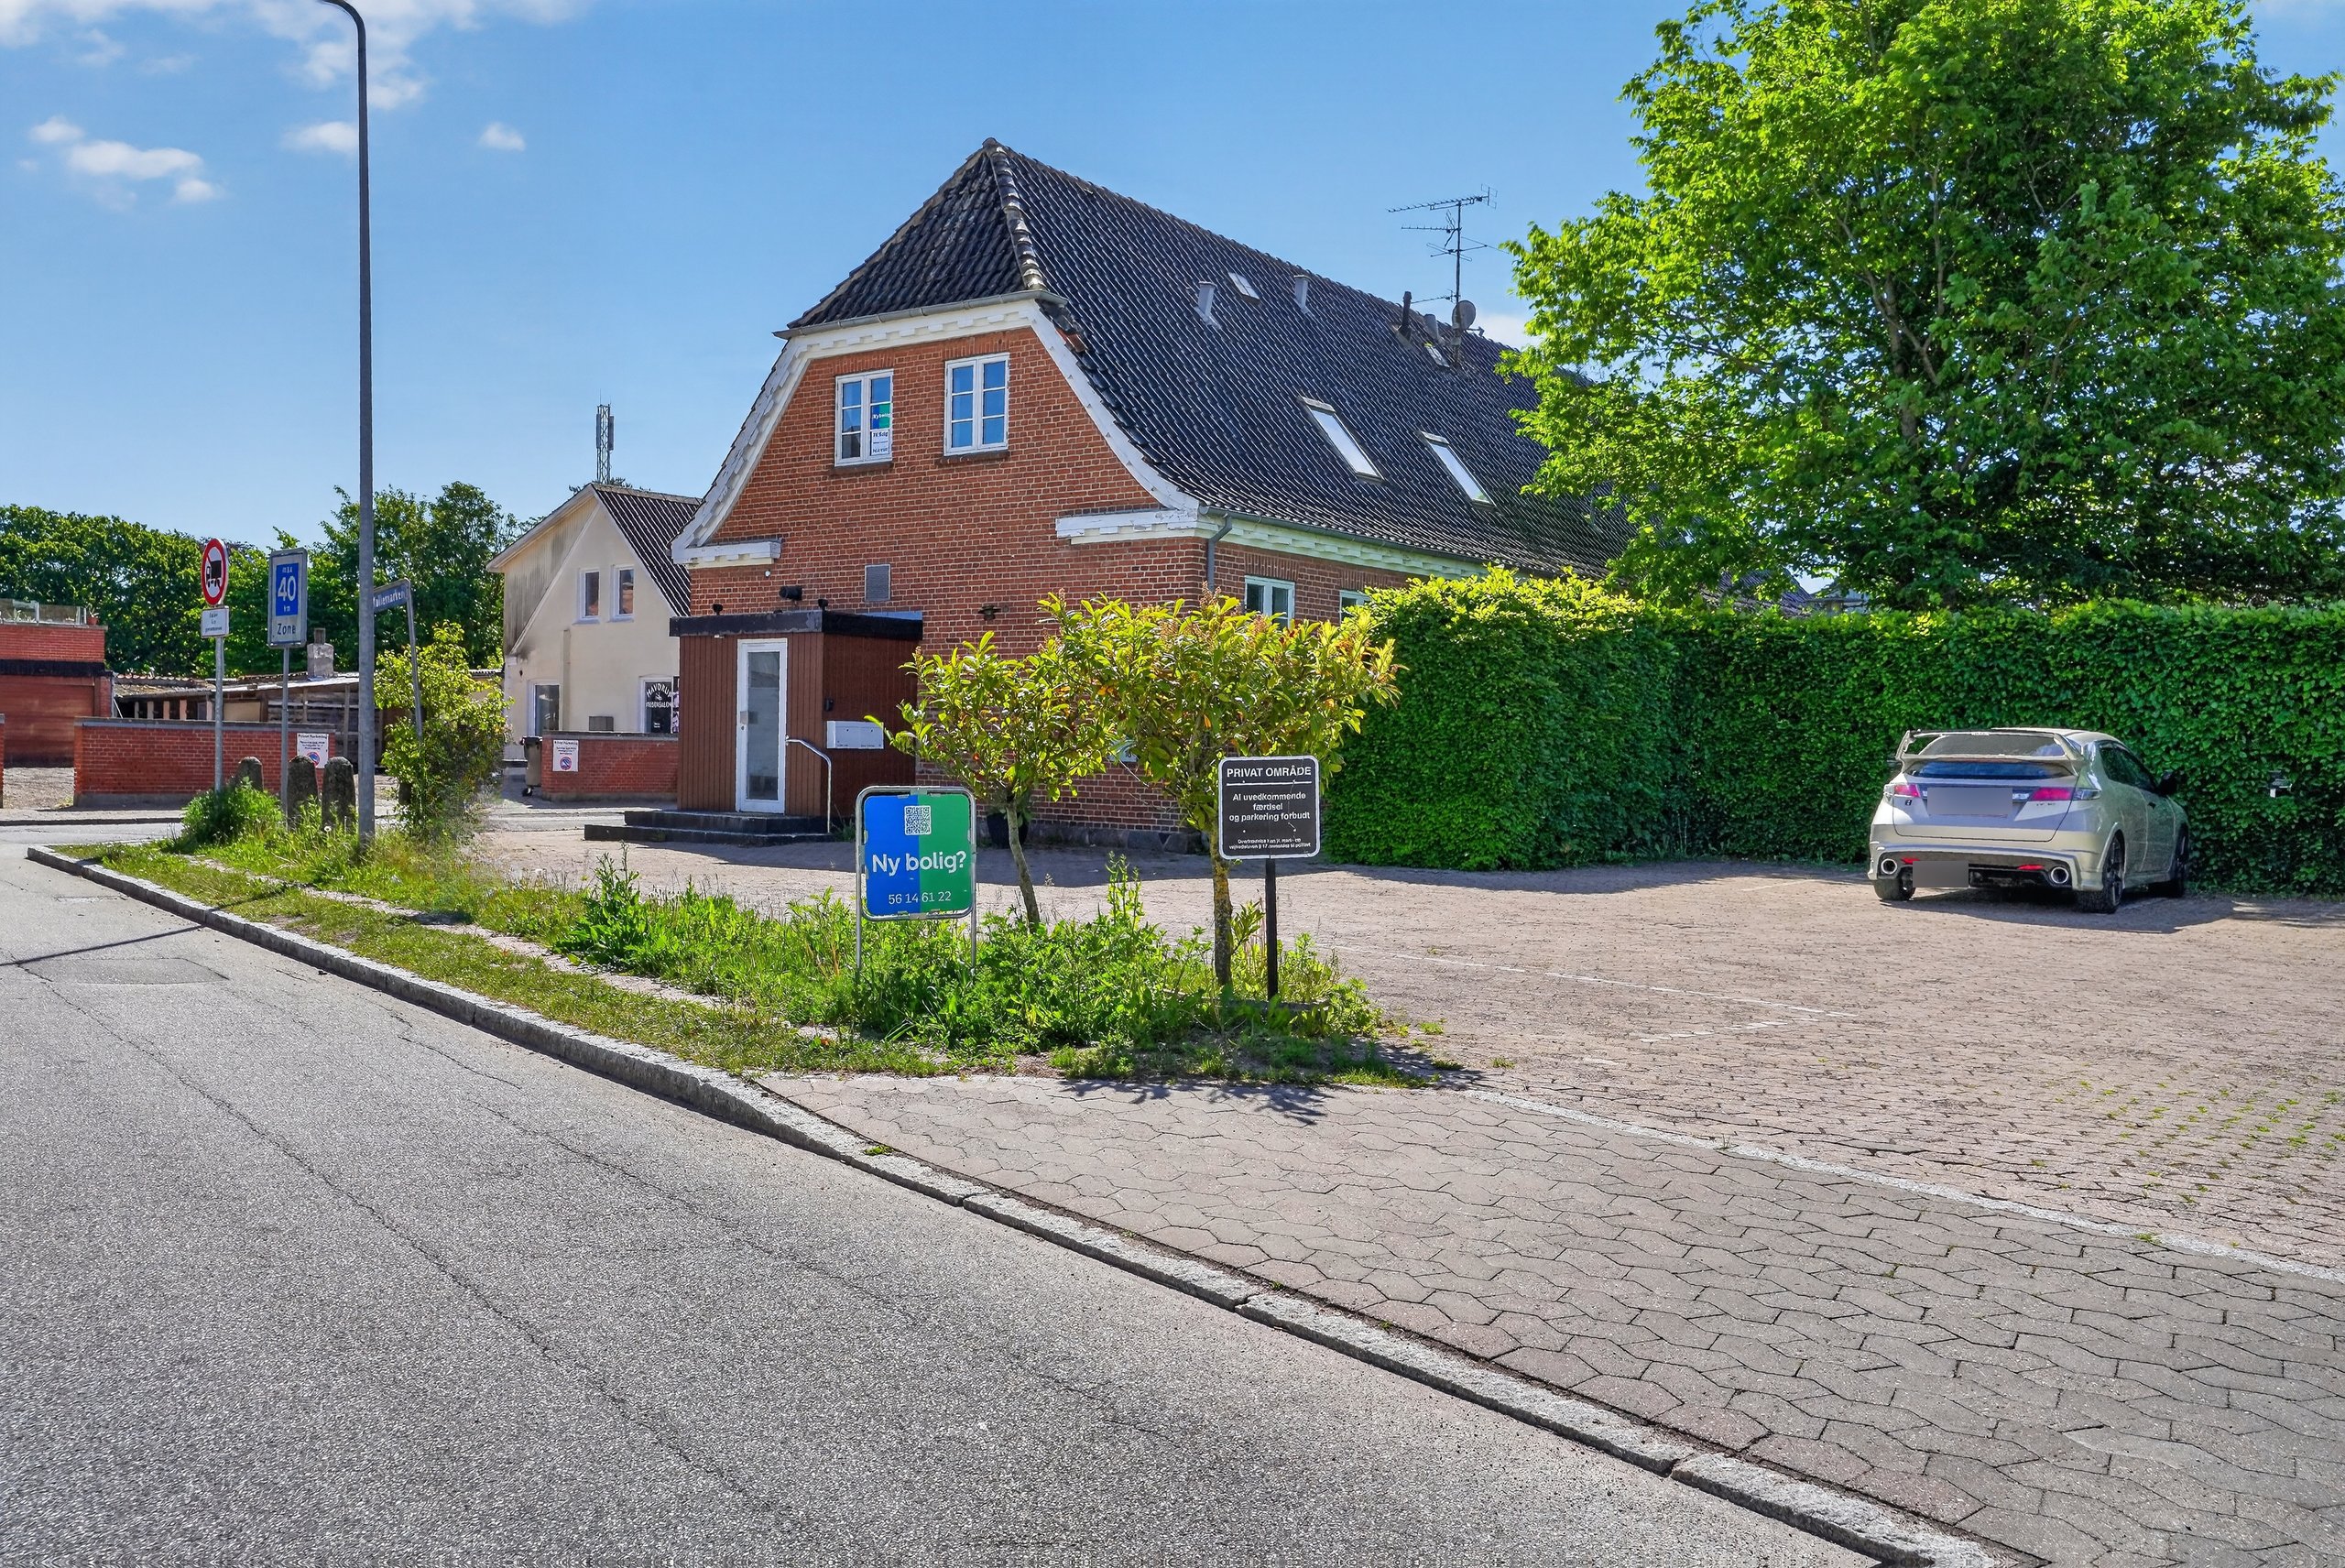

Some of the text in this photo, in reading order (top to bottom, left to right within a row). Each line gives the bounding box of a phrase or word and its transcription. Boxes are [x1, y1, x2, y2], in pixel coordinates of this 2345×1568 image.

[278, 576, 296, 601] 40
[277, 623, 297, 636] Zone
[1227, 765, 1312, 778] PRIVAT OMRÅDE
[1232, 791, 1306, 801] Al uvedkommende
[1252, 802, 1283, 811] færdsel
[1228, 811, 1311, 822] og parkering forbudt
[872, 850, 967, 877] Ny bolig?
[888, 890, 952, 905] 56 14 61 22
